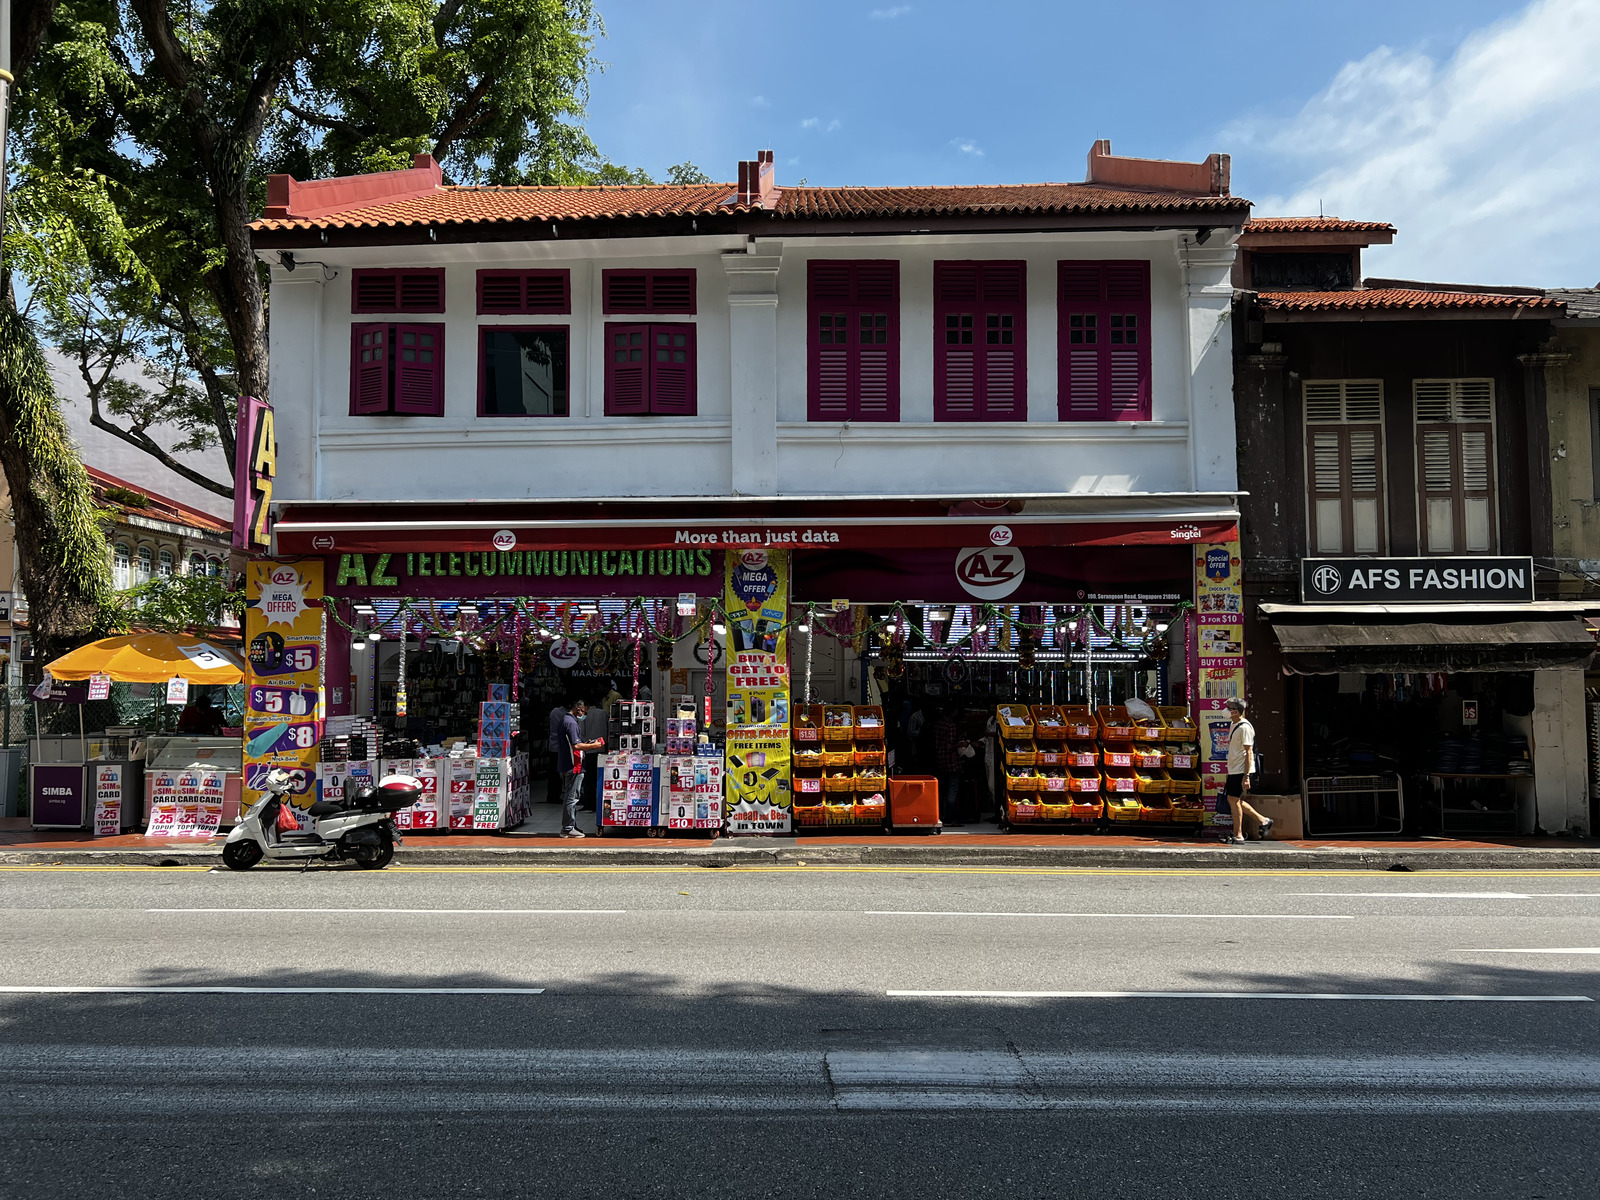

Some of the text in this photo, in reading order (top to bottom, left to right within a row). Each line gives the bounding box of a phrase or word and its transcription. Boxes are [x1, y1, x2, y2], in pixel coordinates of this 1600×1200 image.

[675, 529, 840, 546] More than just data
[991, 531, 1010, 541] AZ
[1170, 528, 1201, 540] Singtel
[494, 535, 514, 545] AZ
[742, 552, 765, 565] AZ
[1207, 554, 1228, 563] Special
[336, 552, 398, 586] AZ
[958, 552, 1020, 586] AZ
[273, 572, 295, 585] AZ
[742, 572, 768, 582] MEGA
[1348, 568, 1401, 589] AFS
[1409, 568, 1525, 589] FASHION
[743, 585, 767, 593] OFFER
[272, 593, 293, 601] MEGA
[267, 601, 297, 613] OFFERS
[1200, 615, 1206, 623] 3
[1221, 615, 1237, 623] $10
[285, 649, 312, 670] $5
[738, 654, 776, 663] BUY 1
[1201, 658, 1243, 666] BUY 1 GET 1
[729, 665, 785, 674] GET 10
[1210, 669, 1226, 678] FREE
[735, 676, 780, 687] FREE
[254, 690, 283, 713] $5
[288, 726, 314, 748] $8
[726, 728, 789, 740] OFFER PRICE
[800, 730, 815, 739] $1.50
[1113, 755, 1130, 764] $3.90
[709, 766, 719, 776] 10
[101, 782, 116, 790] SIM
[605, 781, 623, 790] $10
[697, 784, 718, 793] $179
[803, 781, 819, 790] $1.50
[1081, 780, 1098, 789] $1.30
[42, 787, 73, 796] SIMBA
[97, 791, 120, 799] CARD
[157, 787, 172, 795] SIM
[181, 787, 196, 795] SIM
[204, 788, 219, 796] SIM
[325, 787, 342, 797] $10
[152, 795, 176, 803] CARD
[177, 795, 199, 803] CARD
[199, 796, 222, 804] CARD
[709, 802, 719, 811] 10
[97, 809, 117, 820] $25
[154, 814, 173, 824] $25
[179, 813, 198, 824] $25
[733, 809, 759, 821] cheap
[200, 814, 218, 825] $25
[670, 819, 688, 828] $10
[750, 822, 784, 830] TOWN
